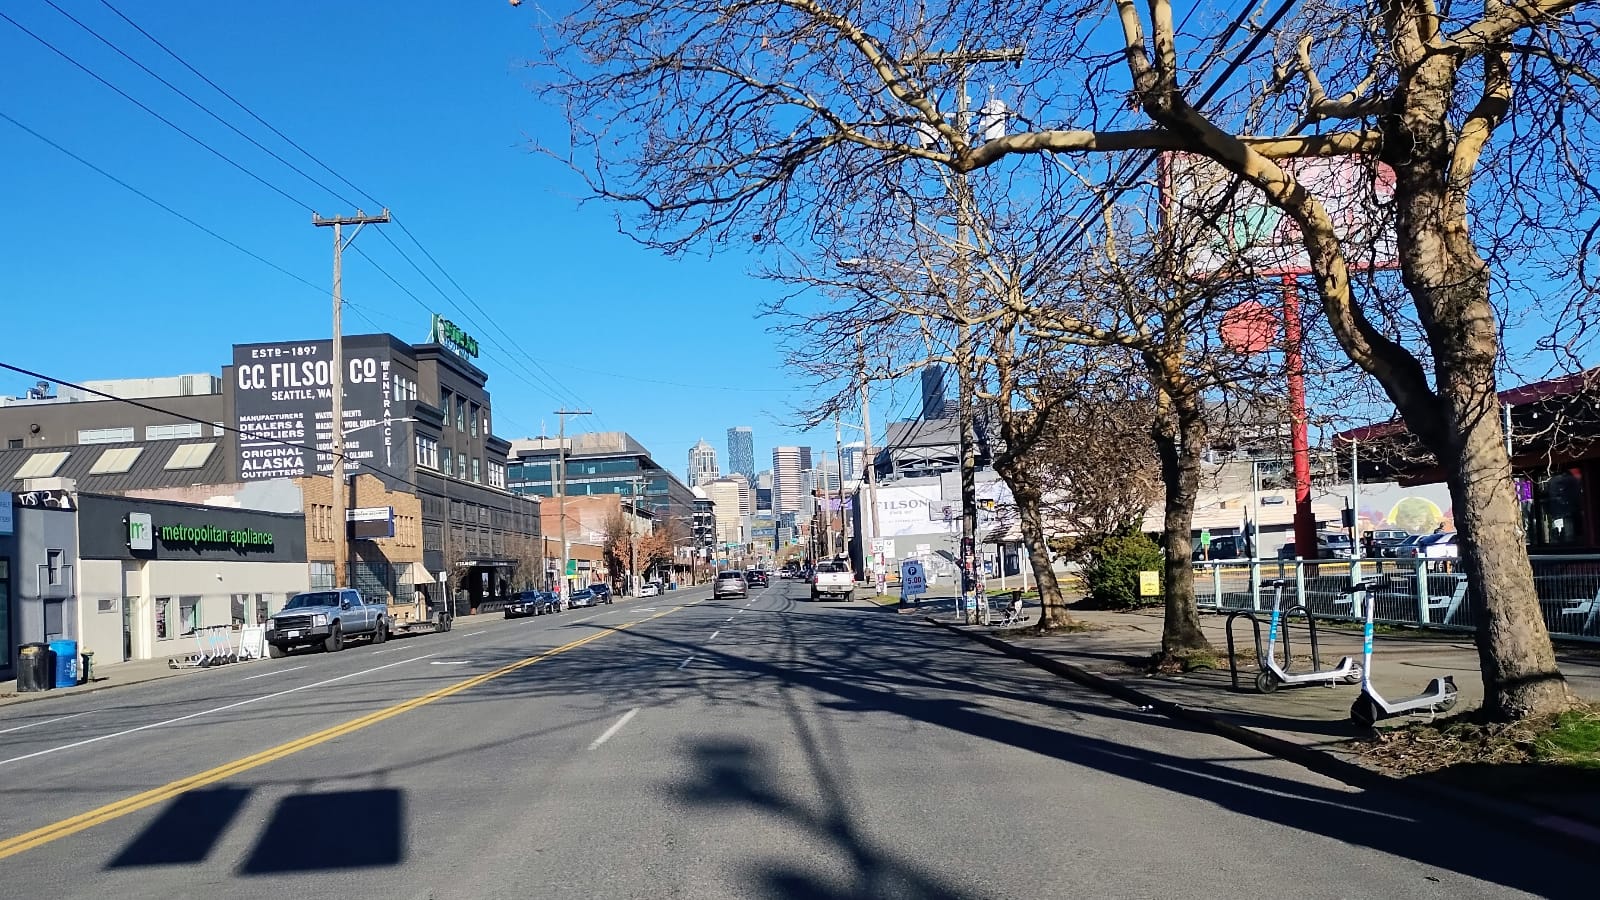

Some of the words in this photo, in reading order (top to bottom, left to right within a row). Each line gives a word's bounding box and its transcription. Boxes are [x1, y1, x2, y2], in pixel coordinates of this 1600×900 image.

[239, 364, 266, 389] C.C.
[271, 389, 315, 400] SEATTLE,
[317, 388, 347, 398] WA.
[240, 413, 304, 422] MANUFACTURERS
[240, 421, 293, 431] DEALERS
[295, 420, 304, 429] &
[240, 429, 304, 441] SUPPLIERS
[242, 448, 304, 459] ORIGINAL
[242, 456, 304, 470] ALASKA
[241, 468, 304, 479] OUTFITTERS
[162, 524, 229, 545] metropolitan
[230, 527, 273, 547] appliance
